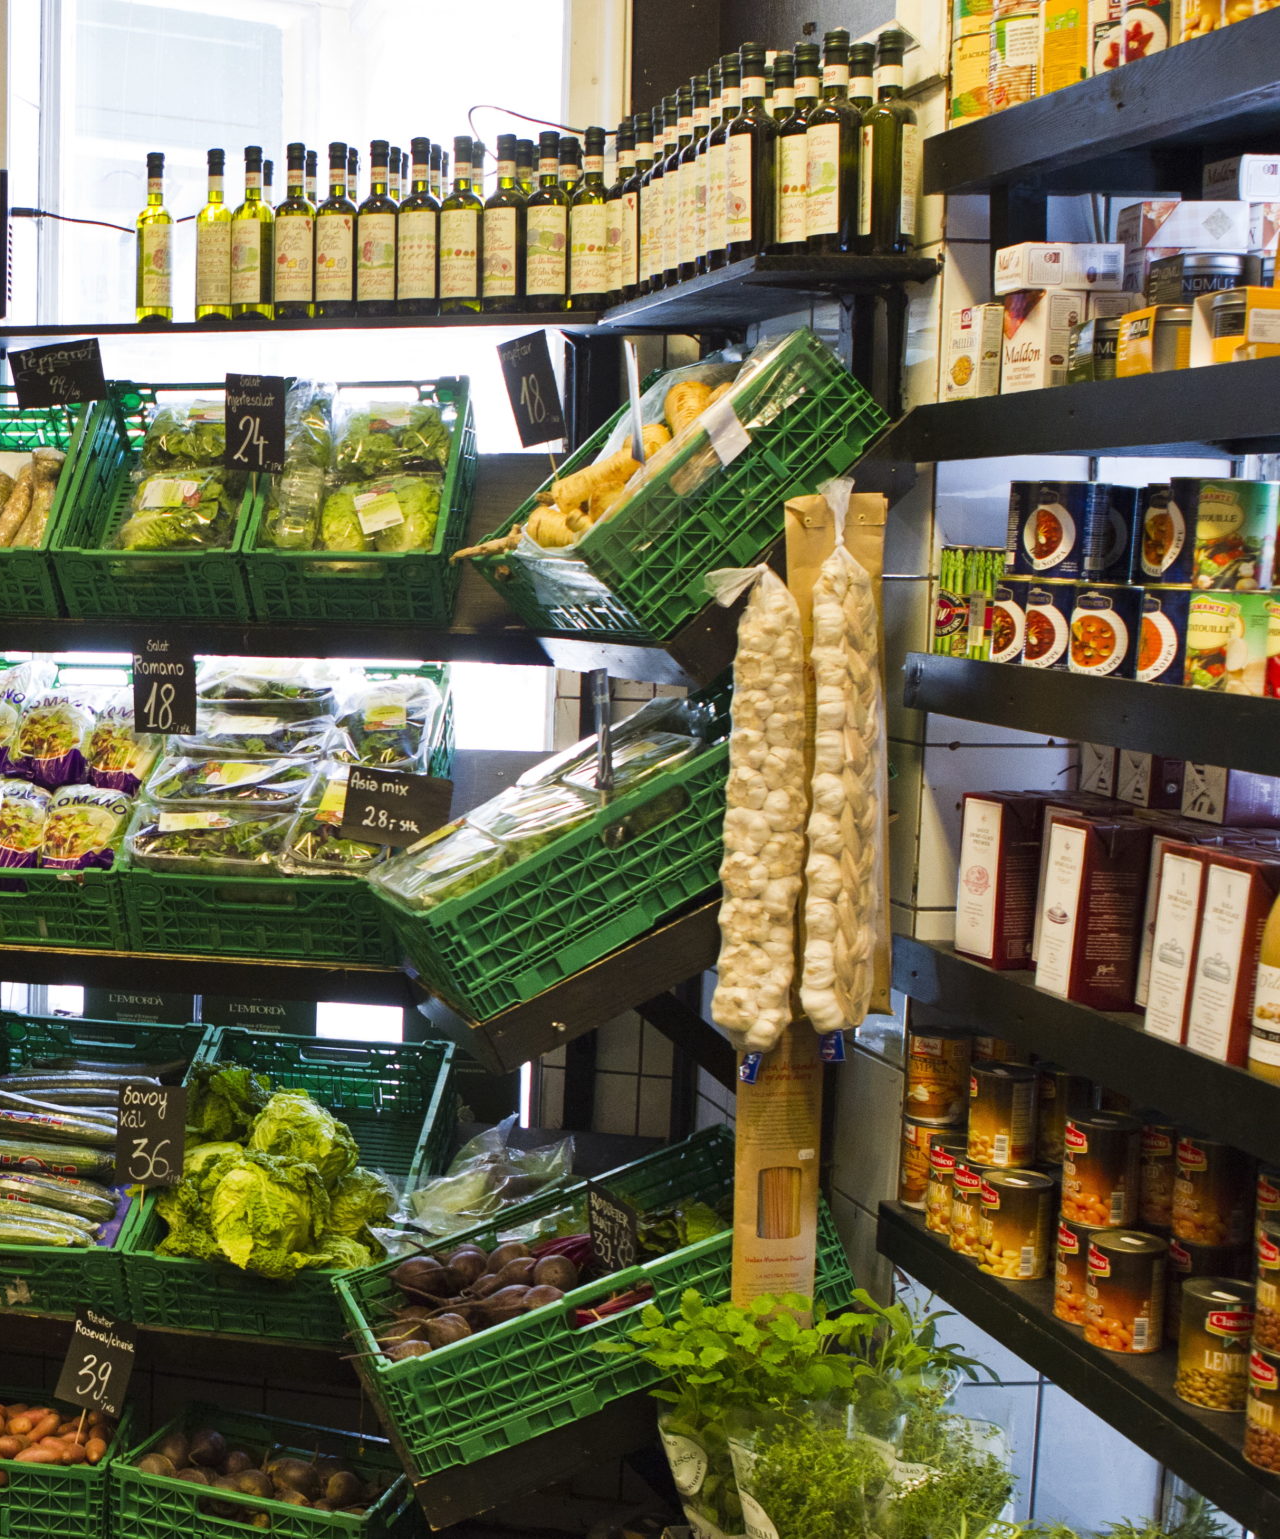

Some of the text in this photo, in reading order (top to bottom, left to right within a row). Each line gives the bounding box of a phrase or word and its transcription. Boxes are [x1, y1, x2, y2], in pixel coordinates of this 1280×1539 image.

[1004, 342, 1041, 365] Maldon
[520, 373, 546, 424] 18
[1040, 550, 1067, 568] SOPPA
[146, 639, 170, 652] Salat
[133, 654, 185, 676] Romano
[143, 681, 176, 730] 18
[350, 771, 409, 796] Asia mix
[123, 1085, 168, 1120] Savoy
[120, 1110, 146, 1128] Kål
[128, 1137, 171, 1180] 36
